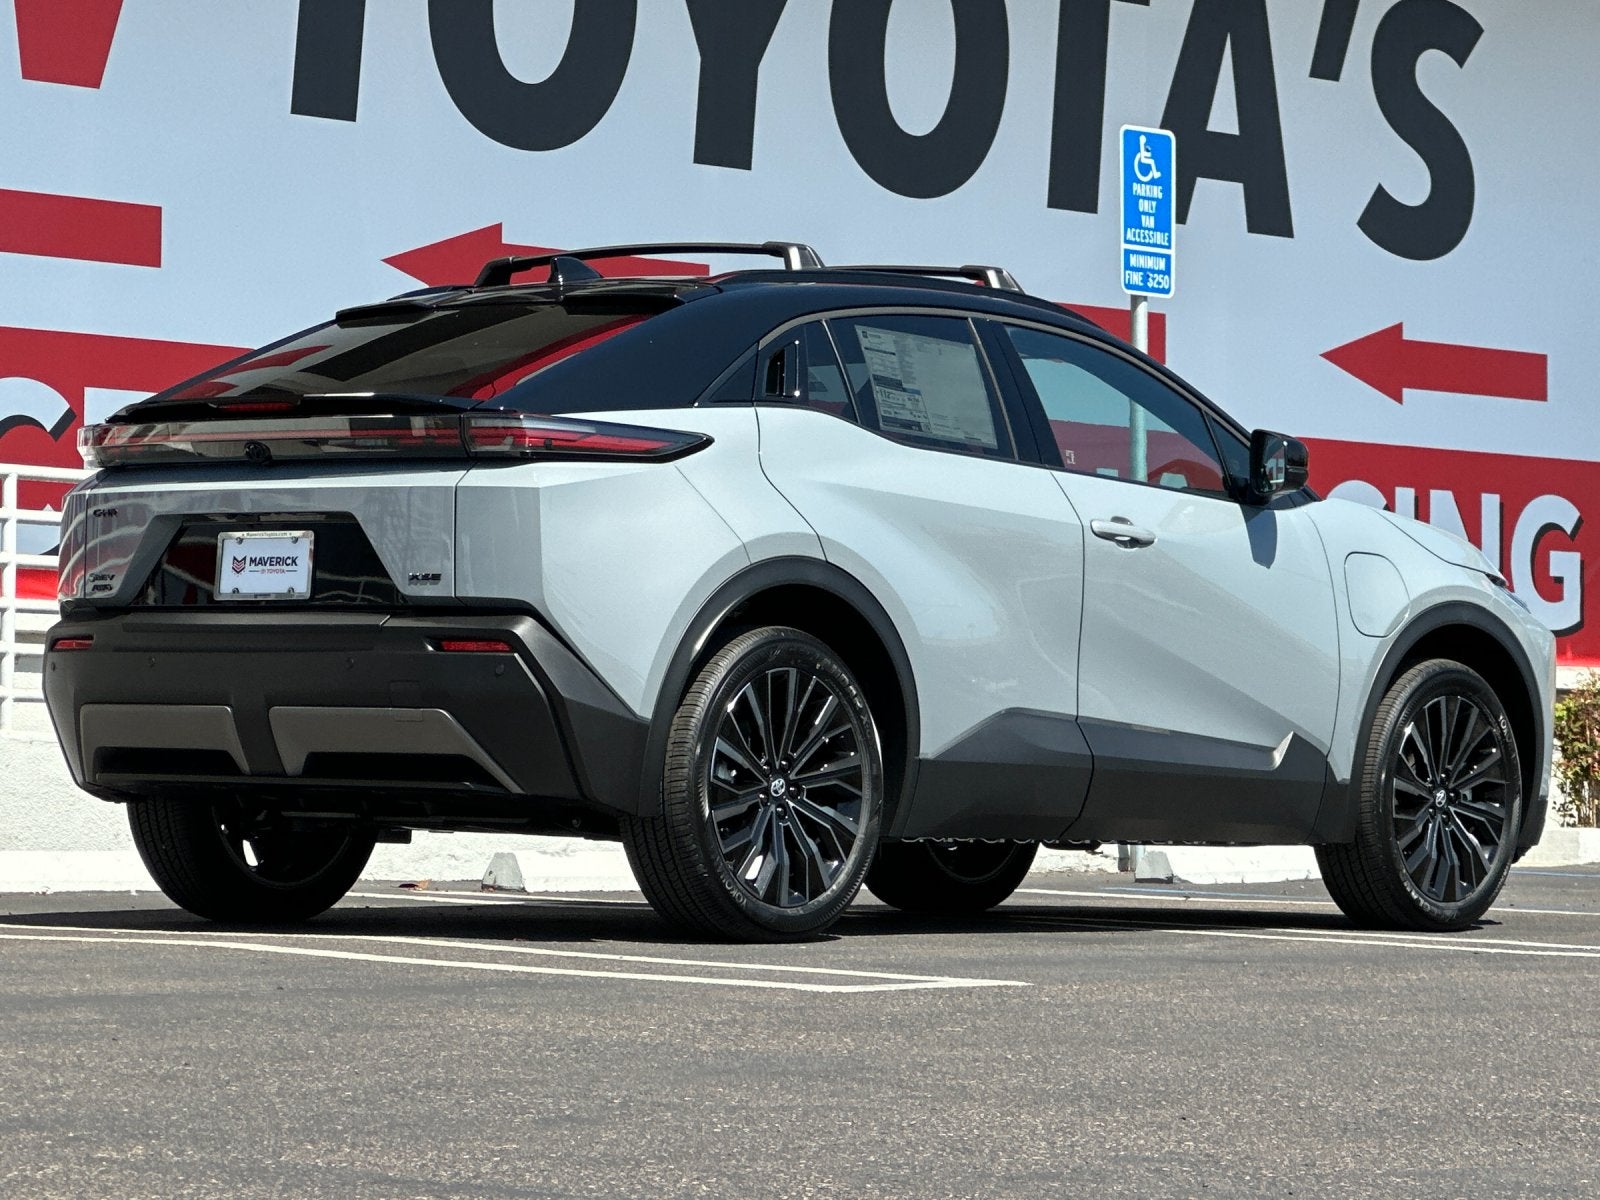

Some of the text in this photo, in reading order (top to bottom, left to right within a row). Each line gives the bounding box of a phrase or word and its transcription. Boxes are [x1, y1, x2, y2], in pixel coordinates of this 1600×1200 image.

[1132, 182, 1163, 199] PARKING
[1138, 199, 1157, 213] ONLY
[1141, 214, 1155, 229] VAN
[1126, 227, 1169, 246] ACCESSIBLE
[1129, 253, 1166, 271] MINIMUM
[1125, 270, 1170, 289] FINE $250
[249, 556, 299, 567] MAVERICK
